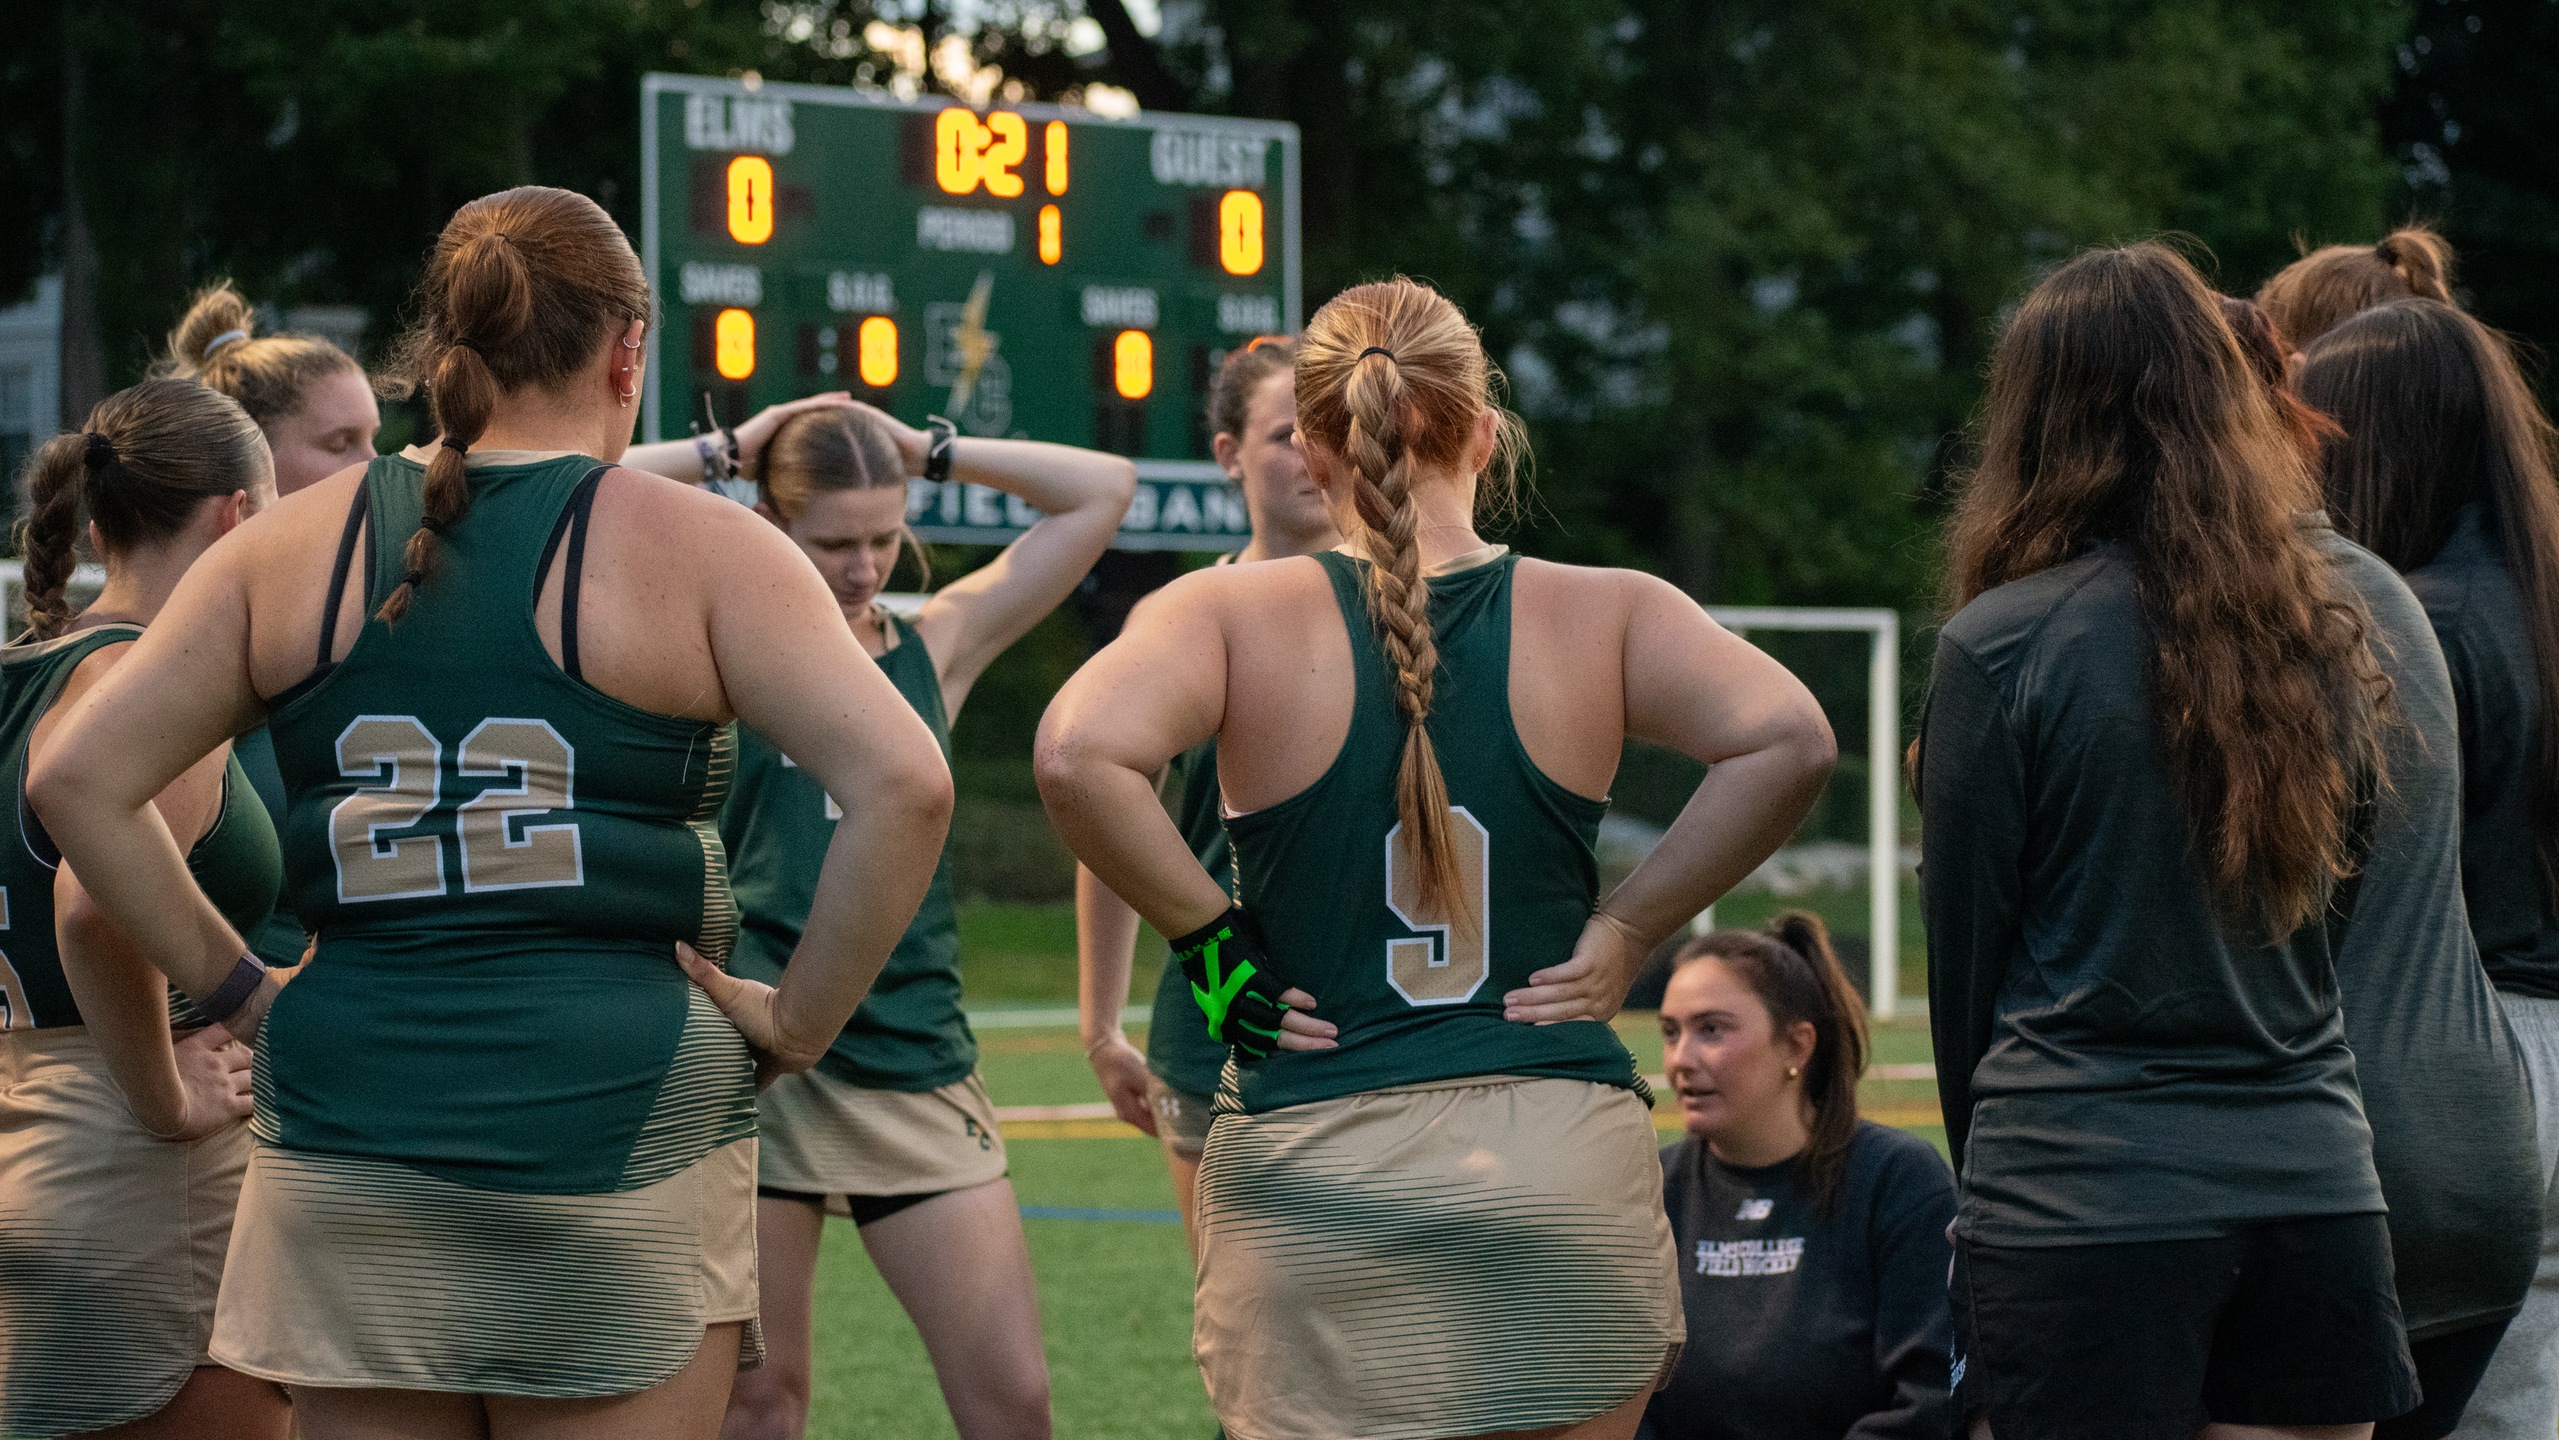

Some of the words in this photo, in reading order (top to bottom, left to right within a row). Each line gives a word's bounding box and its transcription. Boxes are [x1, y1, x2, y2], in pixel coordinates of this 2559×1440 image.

[685, 95, 795, 155] ELMS
[1152, 129, 1266, 187] GUEST
[727, 155, 774, 244] 0
[1039, 203, 1062, 266] 1
[1219, 189, 1264, 277] 0
[1121, 482, 1249, 532] BAN
[328, 714, 585, 904] 22
[1386, 805, 1490, 1007] 9
[1697, 1256, 1740, 1276] FIELD
